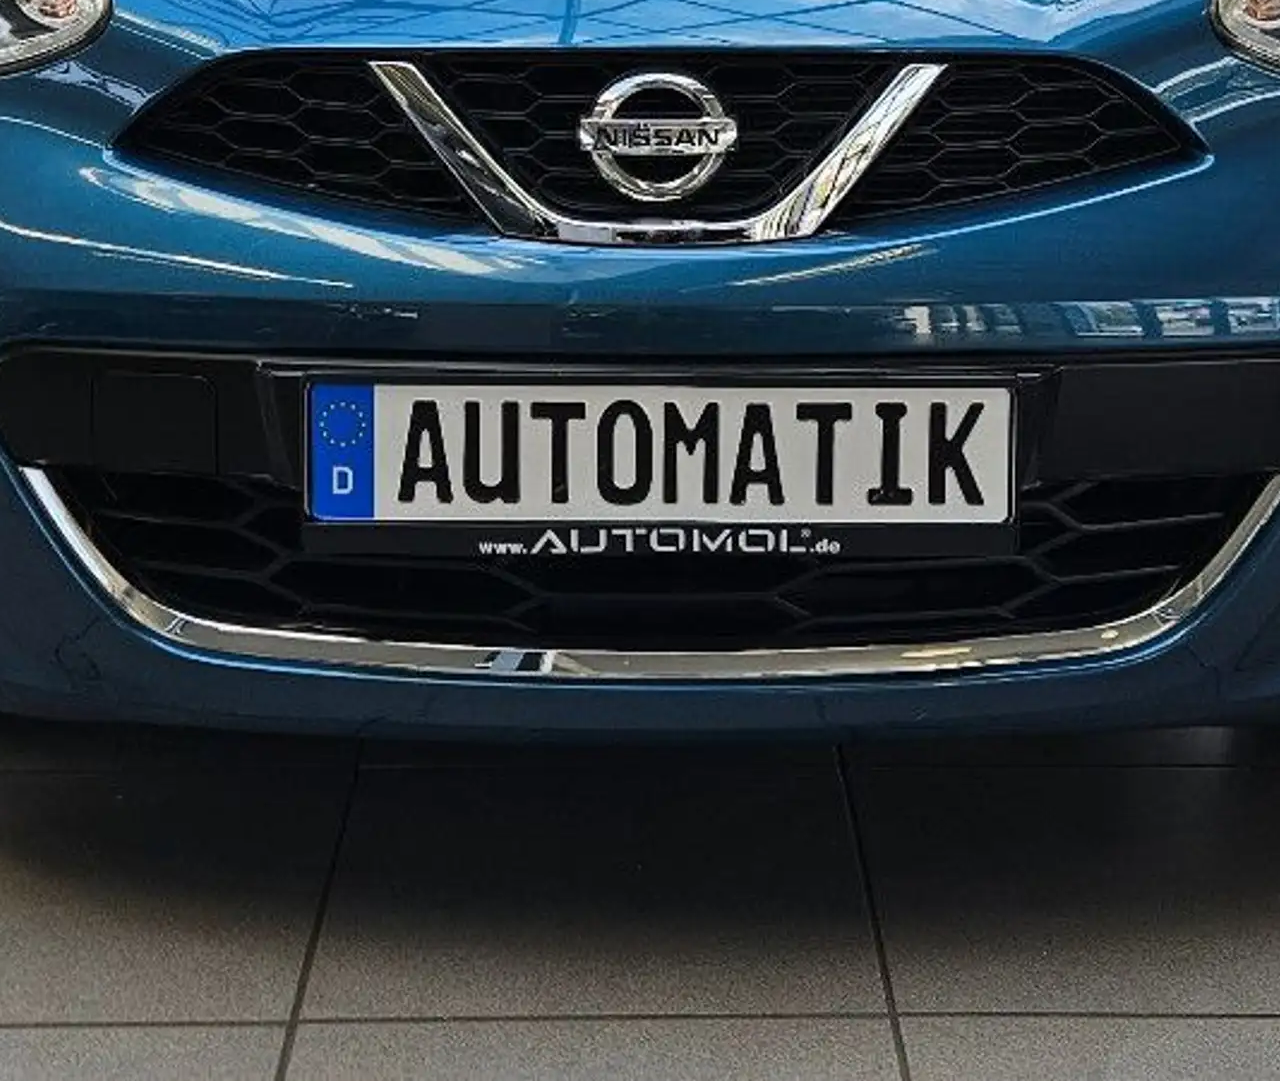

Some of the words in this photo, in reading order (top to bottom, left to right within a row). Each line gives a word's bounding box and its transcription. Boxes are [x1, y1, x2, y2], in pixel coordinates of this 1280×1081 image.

[593, 127, 721, 152] NISSAN
[332, 466, 353, 495] D
[397, 399, 985, 506] AUTOMATIK
